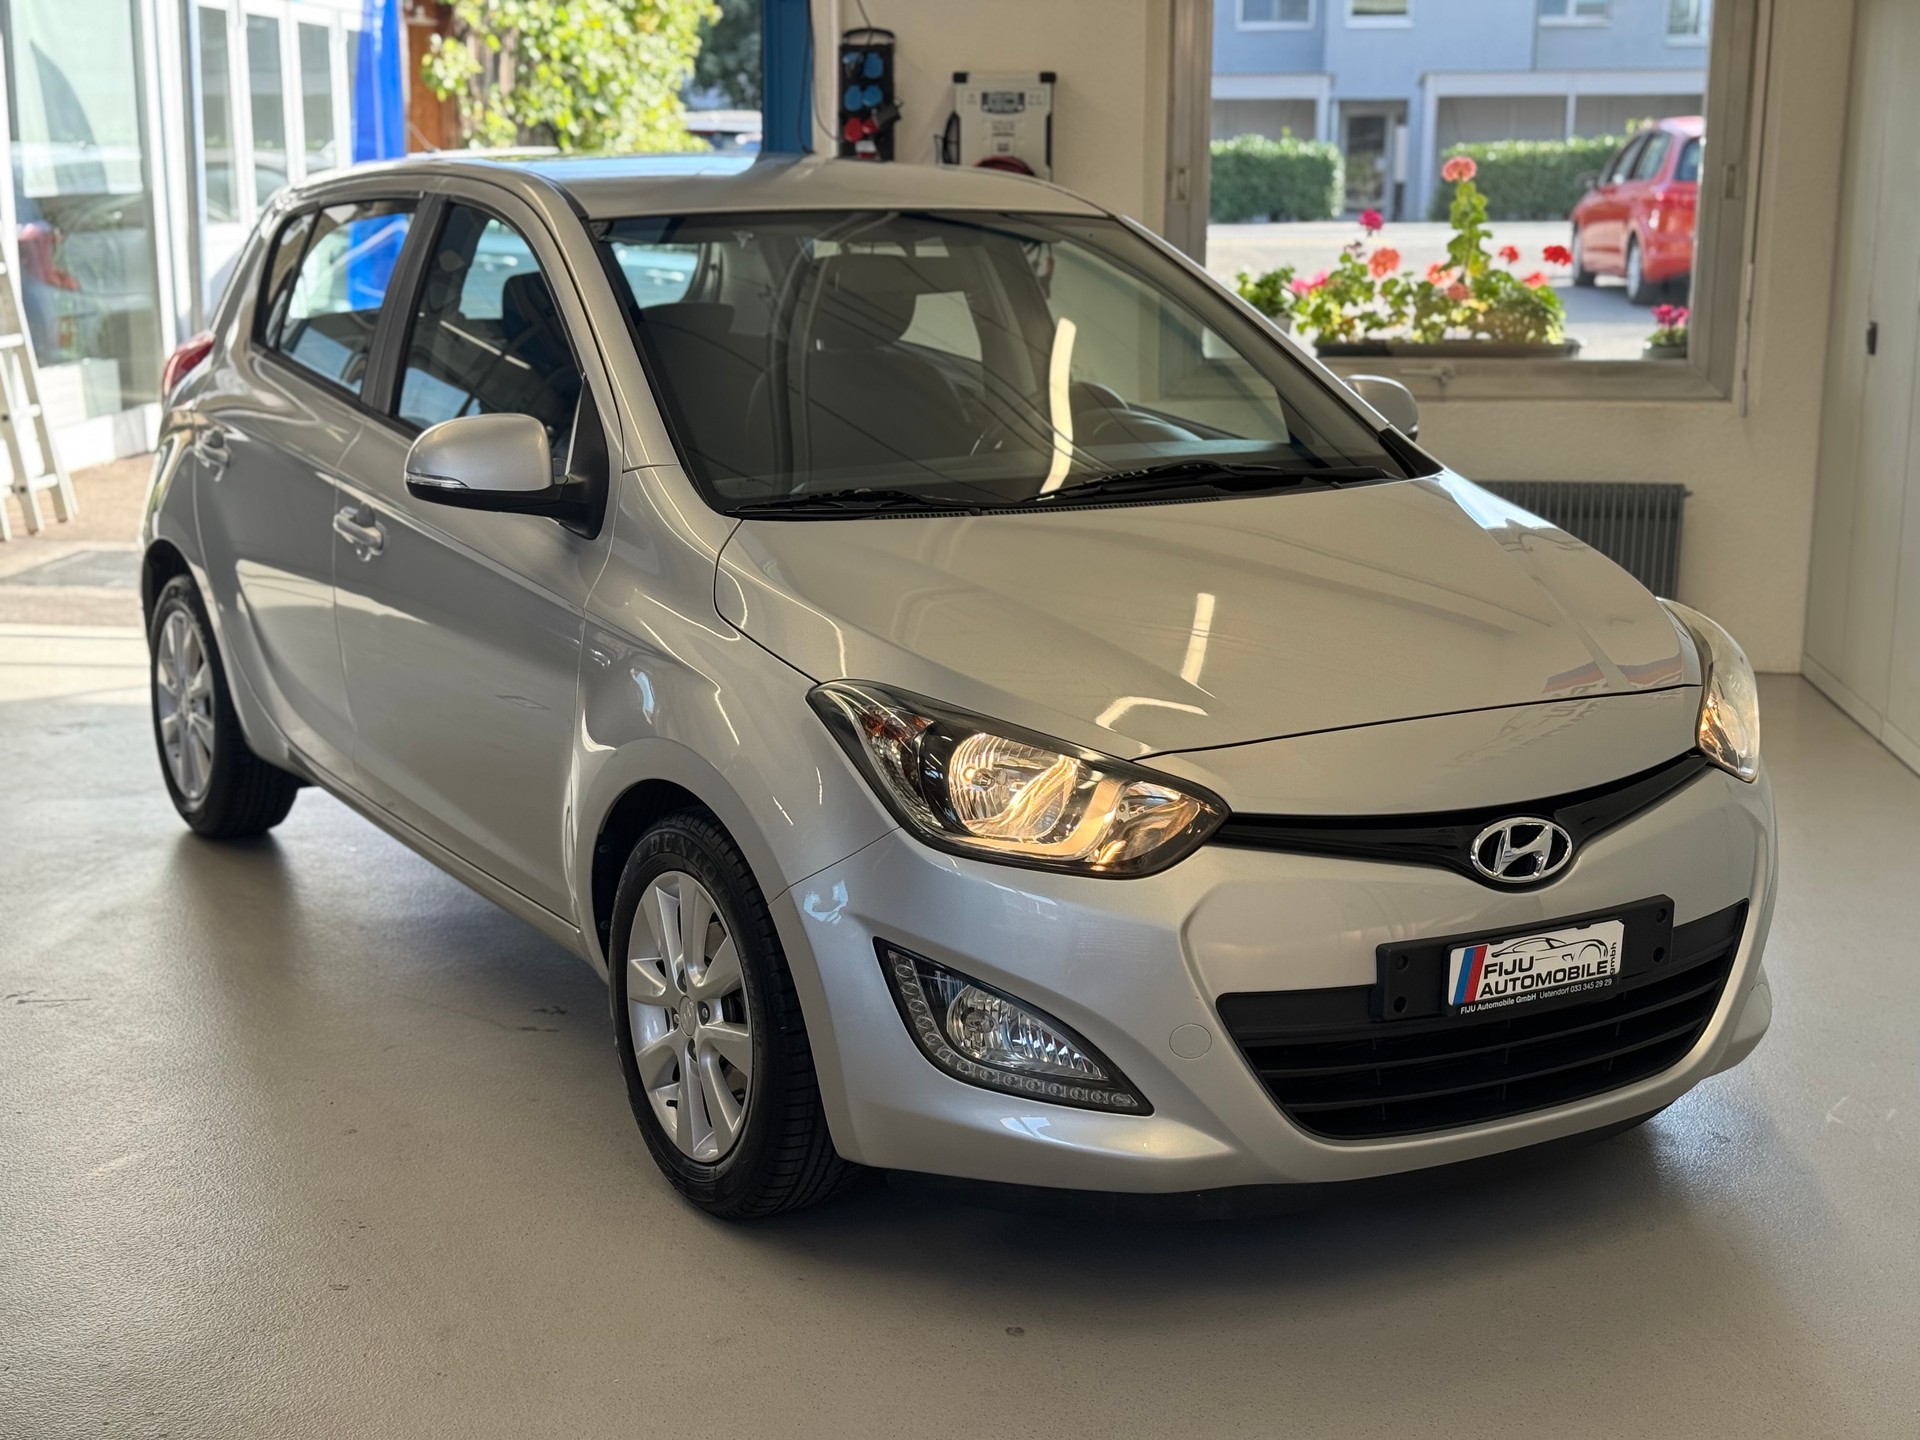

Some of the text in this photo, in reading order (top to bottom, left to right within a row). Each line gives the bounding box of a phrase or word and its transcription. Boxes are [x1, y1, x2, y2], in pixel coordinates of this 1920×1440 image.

[1483, 956, 1534, 979] FIJU
[1609, 942, 1617, 976] gmbh
[1460, 978, 1613, 1014] FIJU Automobile GmbH Uetendorf 033 345 29 29
[1479, 960, 1609, 998] AUTOMOBILE
